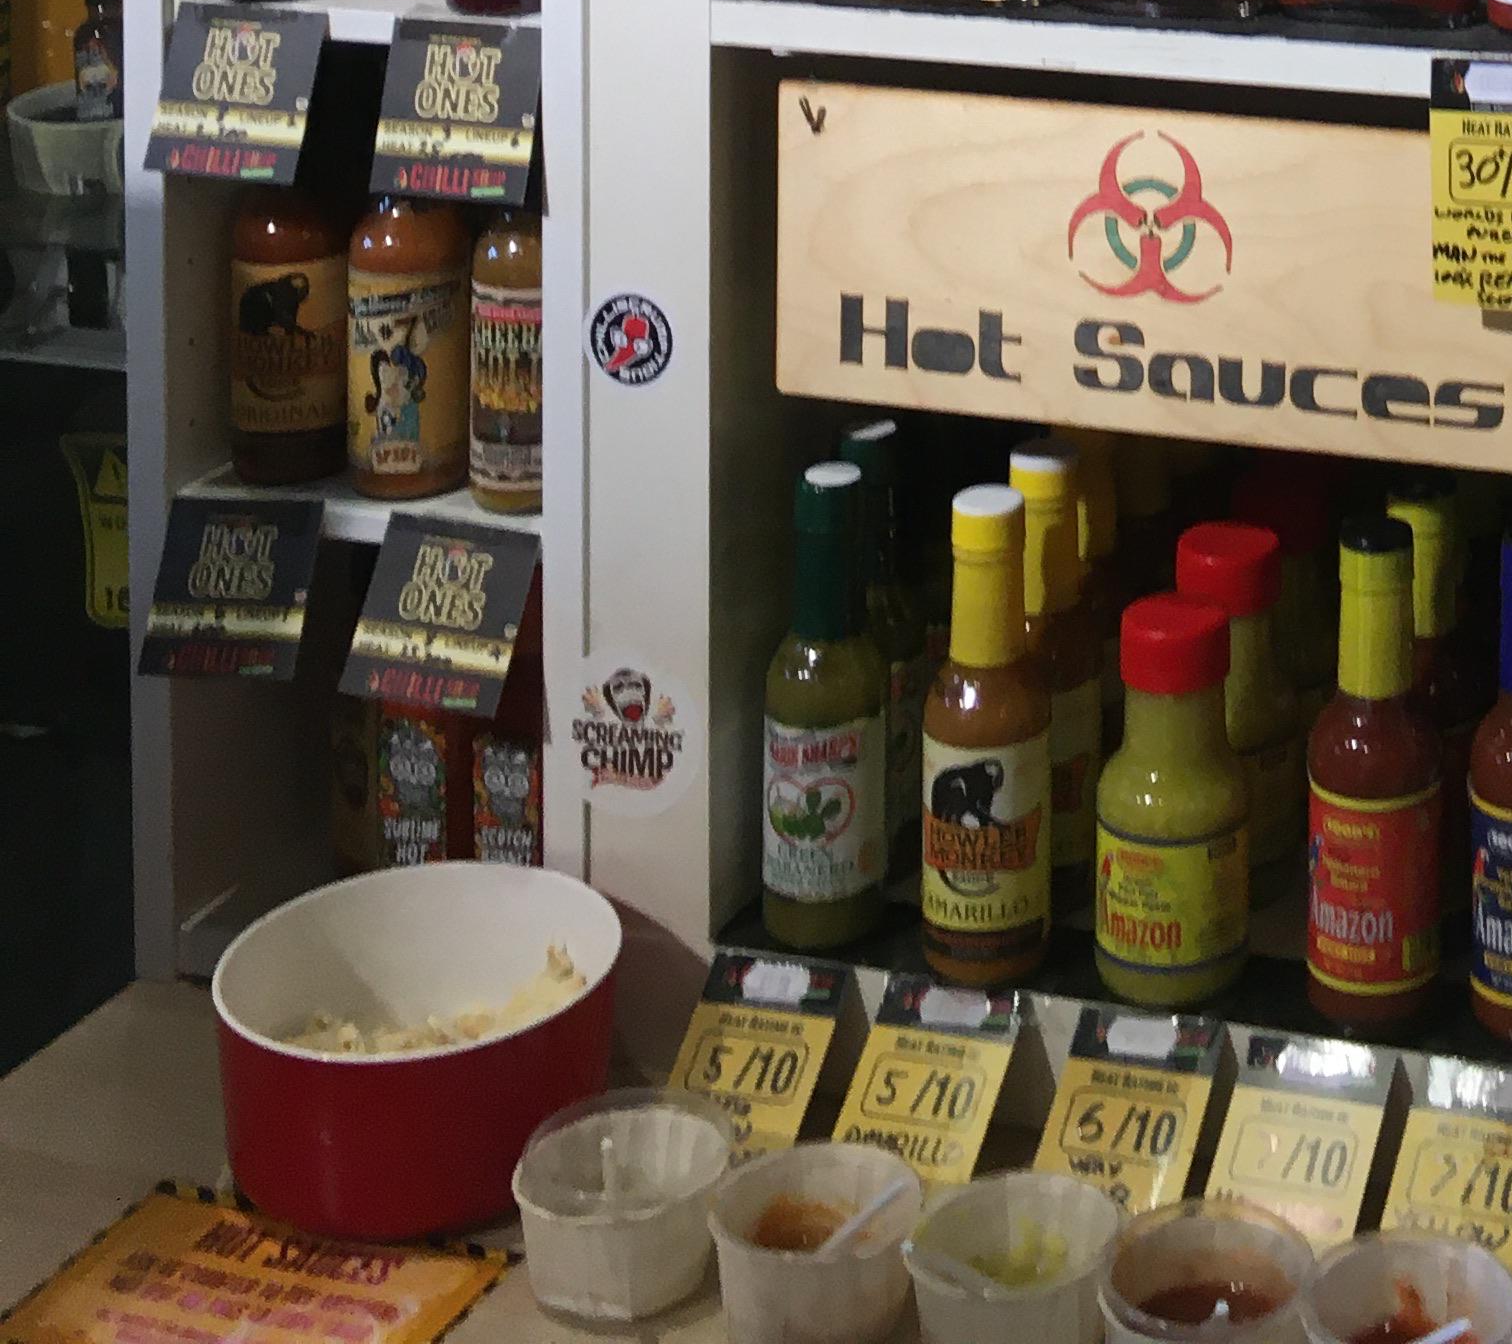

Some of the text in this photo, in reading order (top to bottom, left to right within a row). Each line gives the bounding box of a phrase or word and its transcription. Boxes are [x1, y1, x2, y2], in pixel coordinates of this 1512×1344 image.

[204, 28, 280, 67] HOT
[424, 44, 502, 84] HOT
[193, 62, 276, 106] ONES
[415, 84, 499, 123] ONES
[840, 291, 1505, 433] Hot Sauces
[199, 525, 278, 565] HOT
[188, 556, 275, 600] ONES
[412, 545, 493, 589] HOT
[399, 589, 486, 630] ONES
[581, 744, 673, 778] CHIMP
